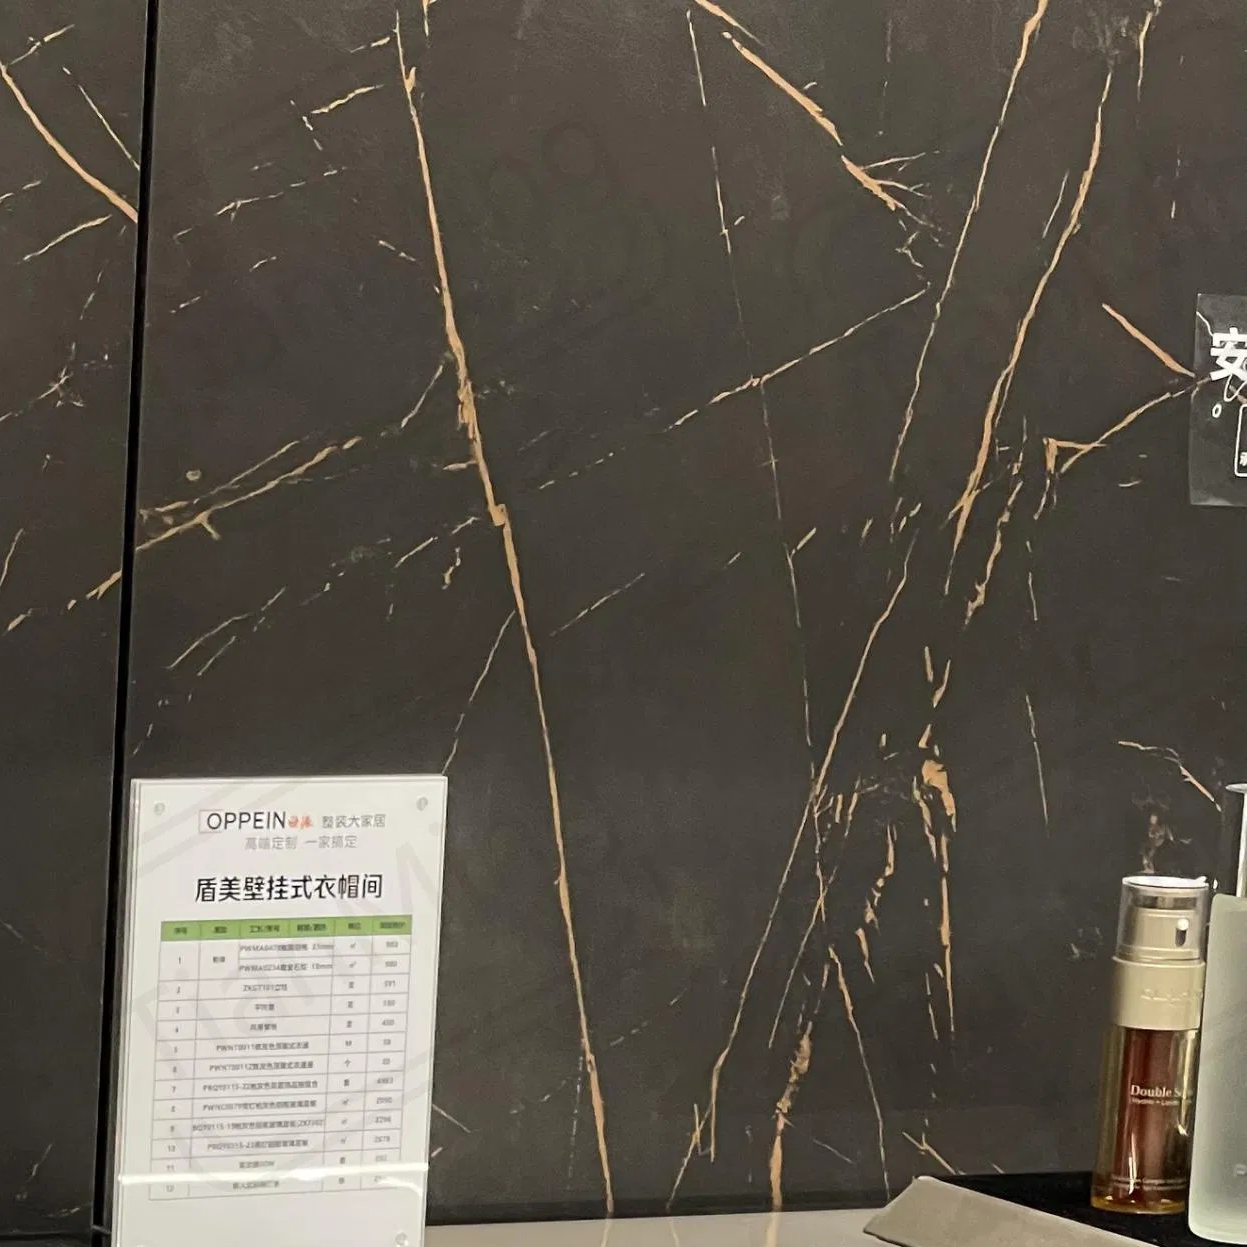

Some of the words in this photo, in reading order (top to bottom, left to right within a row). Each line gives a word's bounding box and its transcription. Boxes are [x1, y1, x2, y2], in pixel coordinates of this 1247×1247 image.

[206, 811, 286, 830] OPPEIN
[195, 873, 384, 903] 盾美壁挂式衣帽间
[1131, 1084, 1173, 1098] Double
